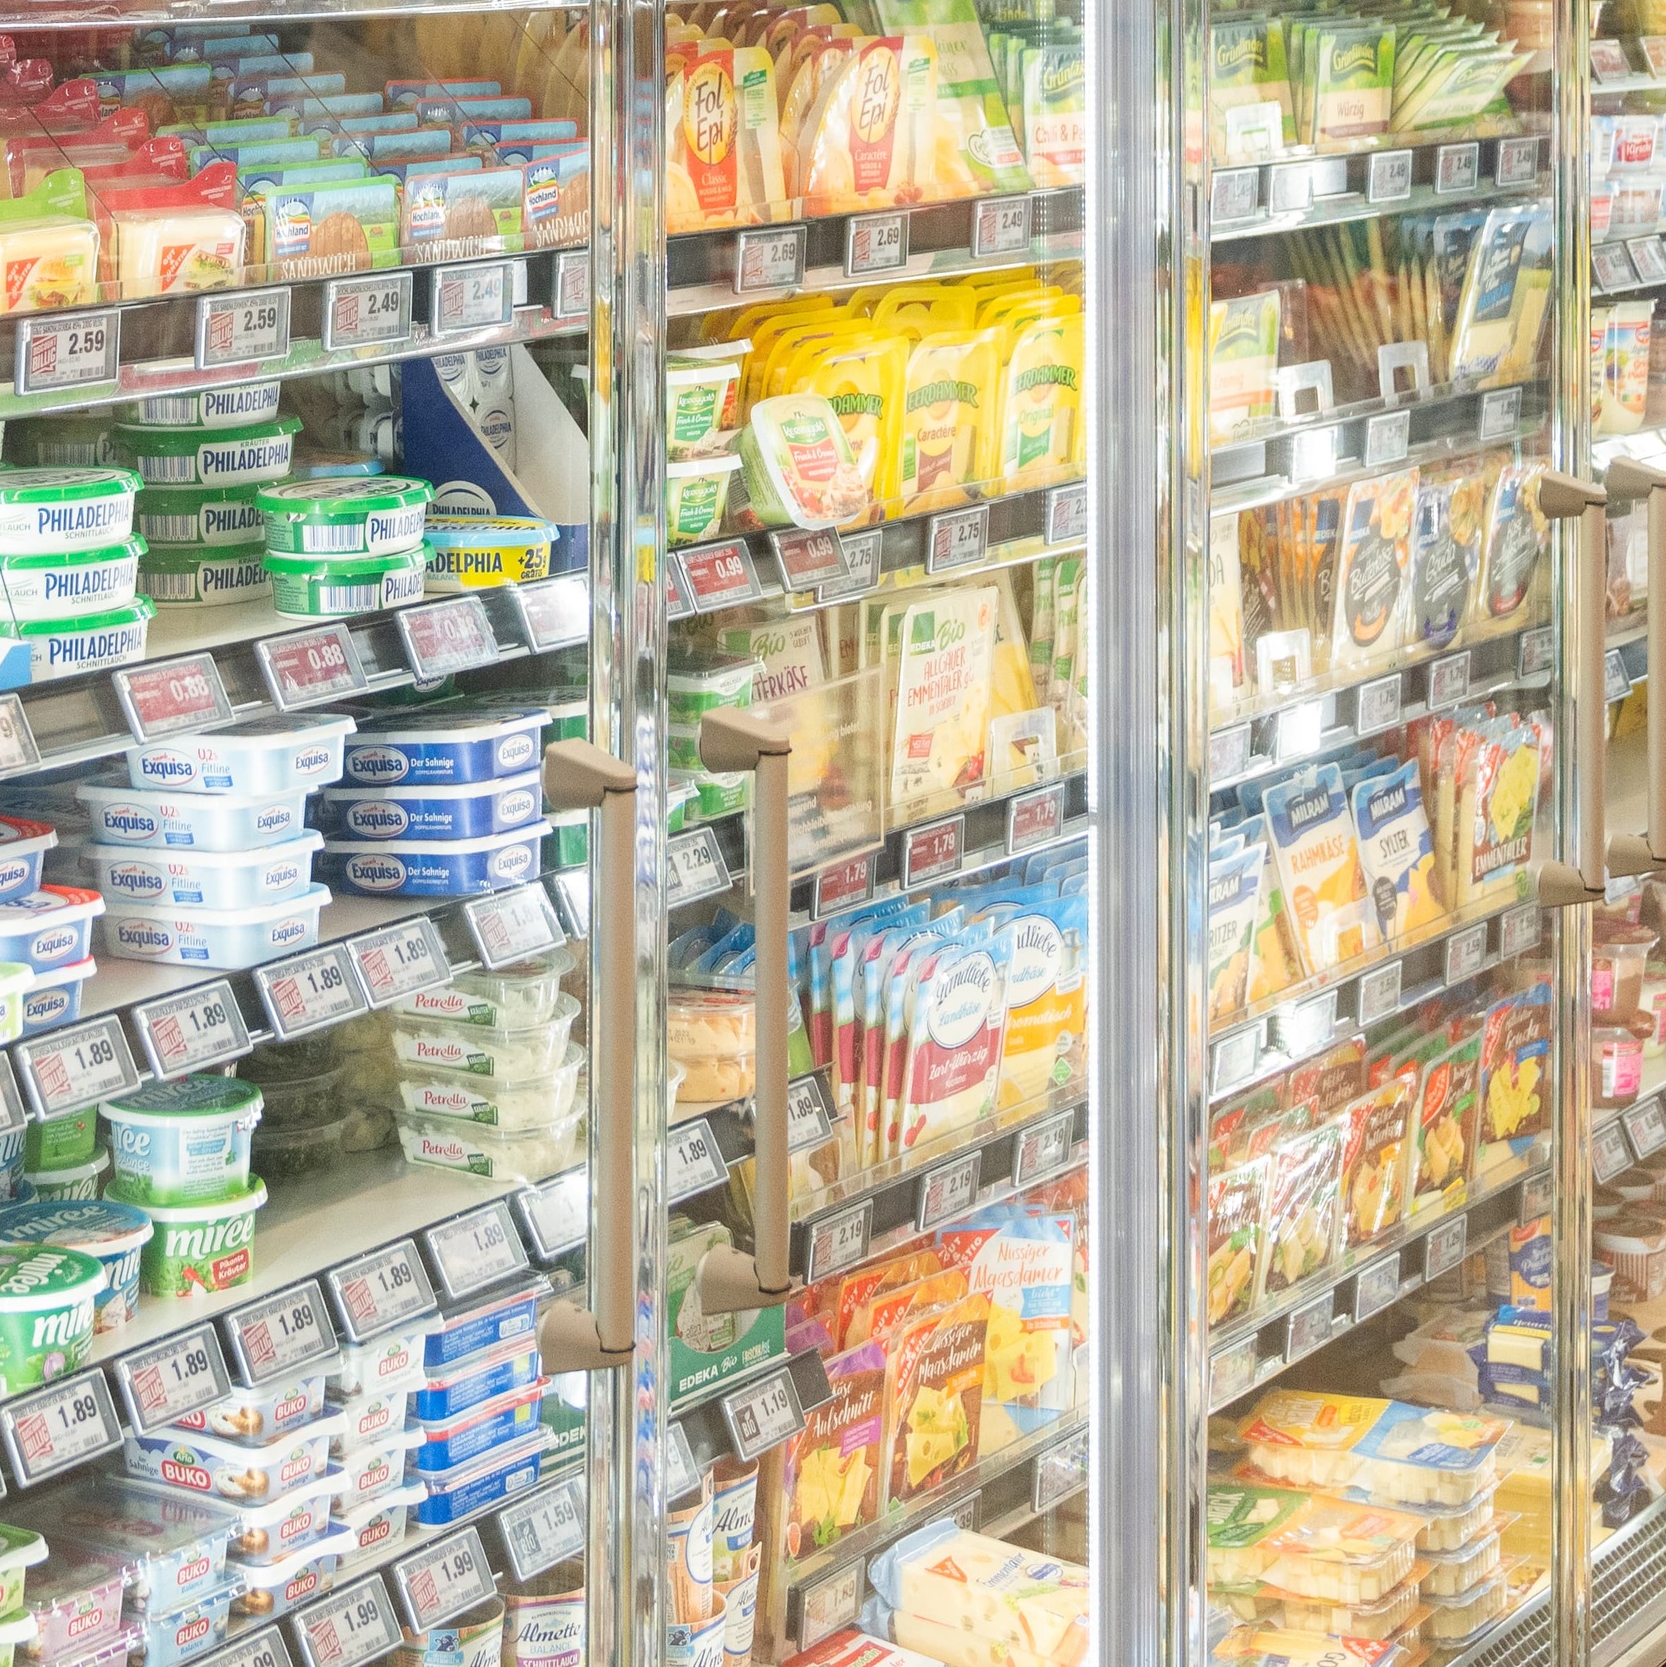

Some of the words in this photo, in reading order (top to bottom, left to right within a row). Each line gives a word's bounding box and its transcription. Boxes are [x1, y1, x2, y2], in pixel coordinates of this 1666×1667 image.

[861, 95, 888, 136] Epi
[1337, 102, 1365, 118] Würzig
[695, 119, 724, 164] Epi
[854, 148, 888, 162] Caractère
[701, 172, 728, 186] Classic
[1002, 209, 1024, 229] 2.49
[878, 228, 899, 245] 2.69
[771, 243, 795, 262] 2.69
[280, 254, 356, 280] SANDWICH
[368, 293, 399, 314] 2.49
[244, 309, 277, 331] 2.59
[69, 331, 105, 355] 2.59
[917, 424, 956, 442] Caractère
[203, 446, 289, 474] PHILADELPHIA
[958, 522, 980, 542] 2.75
[715, 556, 743, 578] 0.99
[45, 565, 133, 600] PHILADELPHIA
[911, 641, 935, 651] EDEKA
[937, 619, 965, 651] Bio
[307, 644, 344, 669] 0.88
[907, 670, 962, 707] EMMENTALER
[142, 759, 192, 776] Exquisa
[201, 763, 231, 775] Fitline
[295, 752, 329, 770] Exquisa
[353, 755, 403, 773] Exquisa
[411, 758, 428, 768] Der
[431, 757, 454, 770] Sahnige
[1290, 792, 1330, 827] MILRAM
[1369, 785, 1406, 820] MILRAM
[352, 809, 402, 828] Exquisa
[411, 813, 428, 823] Der
[431, 812, 453, 824] Sahnige
[934, 834, 955, 854] 1.79
[1291, 834, 1345, 875] RAHMKÄSE
[1379, 828, 1411, 859] SYLTER
[684, 847, 712, 870] 2.29
[1475, 836, 1528, 876] EMMENTALER
[393, 938, 428, 964] 1.89
[306, 966, 343, 992] 1.89
[415, 993, 464, 1013] Petrella
[189, 1004, 225, 1031] 1.89
[74, 1040, 114, 1068] 1.89
[424, 1091, 468, 1109] Petrella
[678, 1139, 707, 1164] 1.89
[949, 1169, 971, 1191] 2.19
[218, 1253, 245, 1270] Pikante
[997, 1242, 1051, 1264] Nussiger
[218, 1263, 247, 1279] Kräuter
[378, 1263, 411, 1291] 1.89
[973, 1264, 1063, 1290] Maasdamer
[679, 1365, 719, 1393] EDEKA
[59, 1394, 97, 1428] 1.89
[277, 1398, 306, 1416] BUKO
[760, 1390, 788, 1416] 1.19
[164, 1462, 208, 1487] BUKO
[542, 1504, 574, 1531] 1.59
[345, 1602, 378, 1630] 1.99
[518, 1623, 581, 1643] Almette
